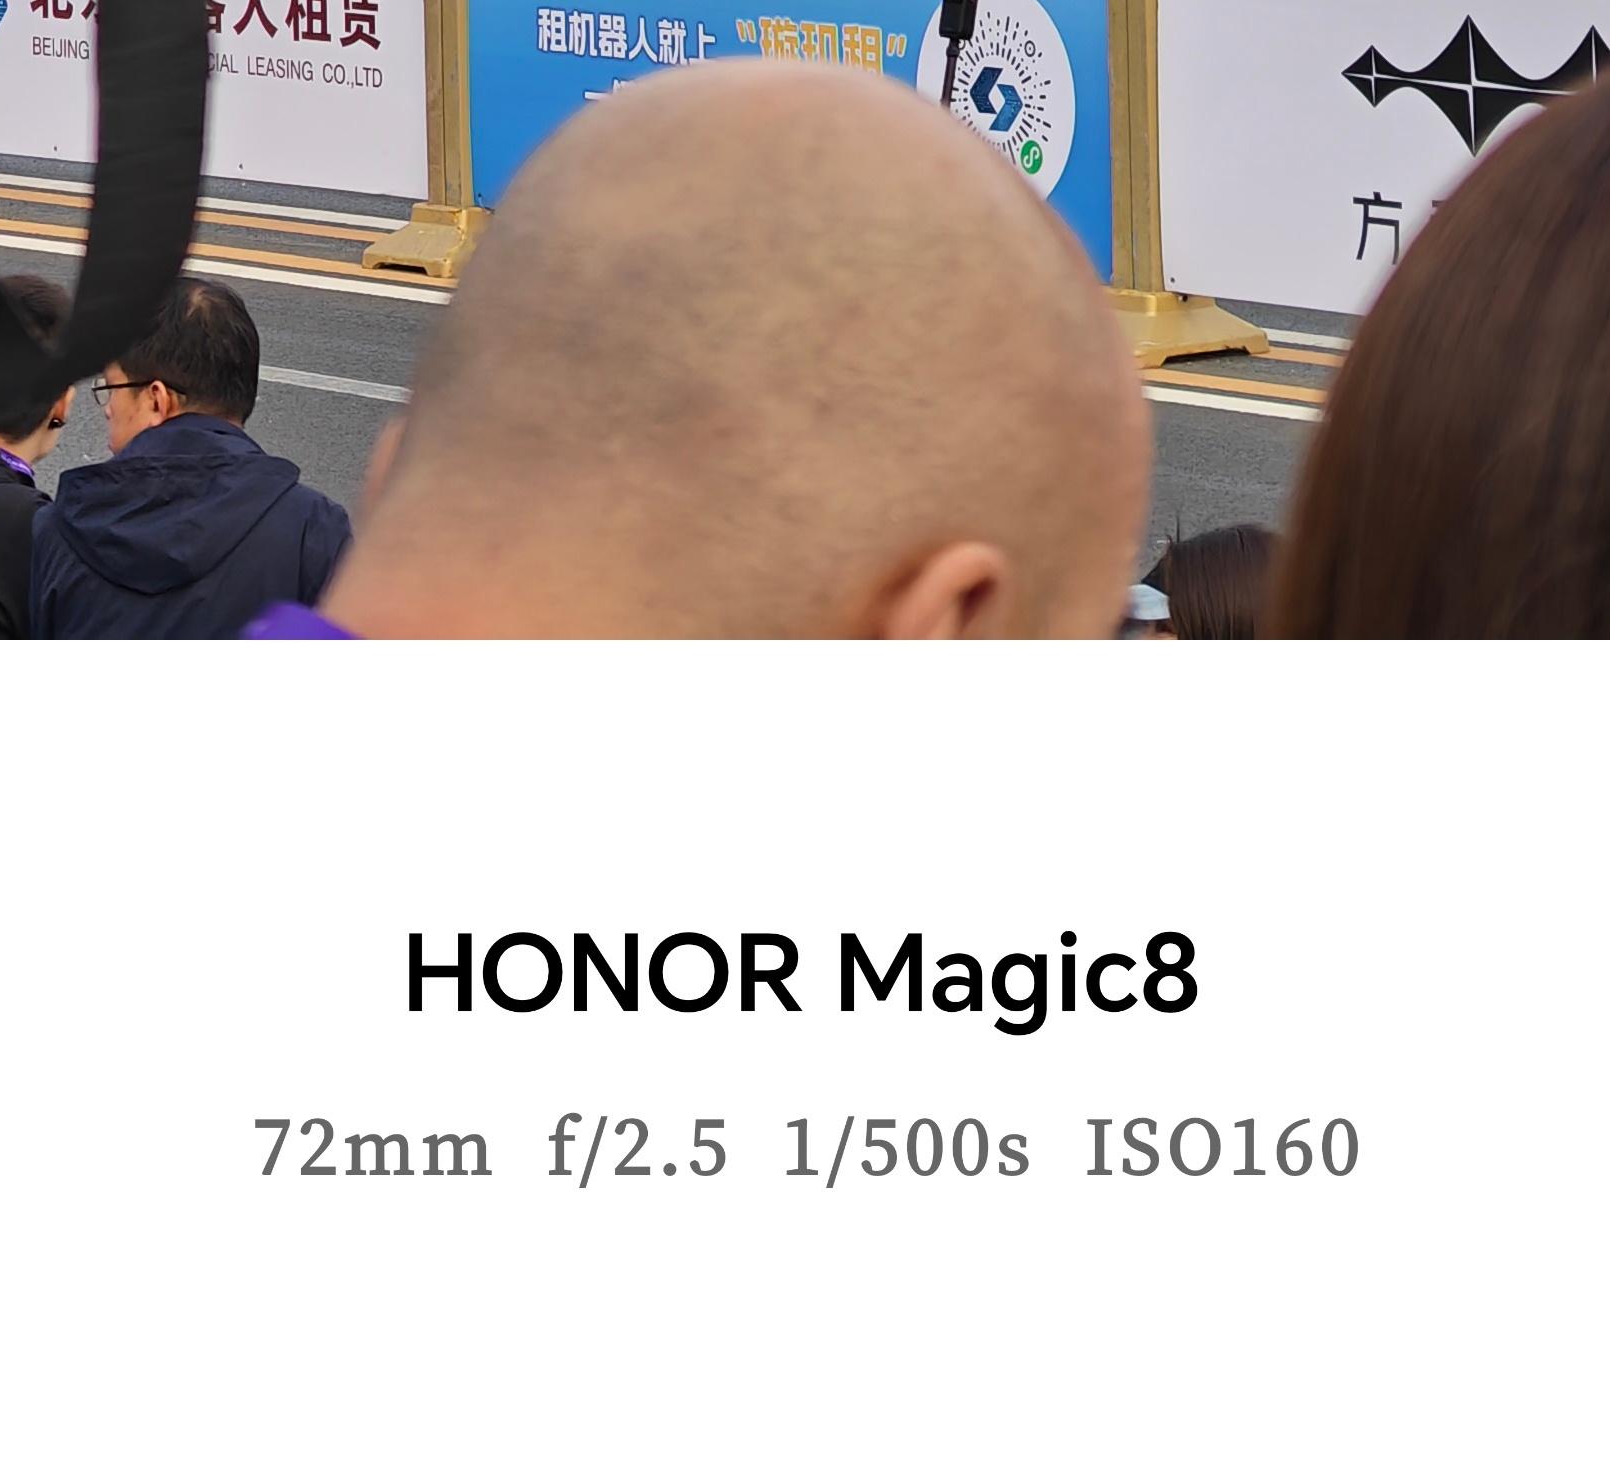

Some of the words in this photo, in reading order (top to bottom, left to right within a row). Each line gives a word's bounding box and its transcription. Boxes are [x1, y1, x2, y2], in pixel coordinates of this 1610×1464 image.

[32, 36, 90, 60] BEIJING
[536, 7, 717, 66] 租机器人就上
[246, 55, 314, 81] LEASING
